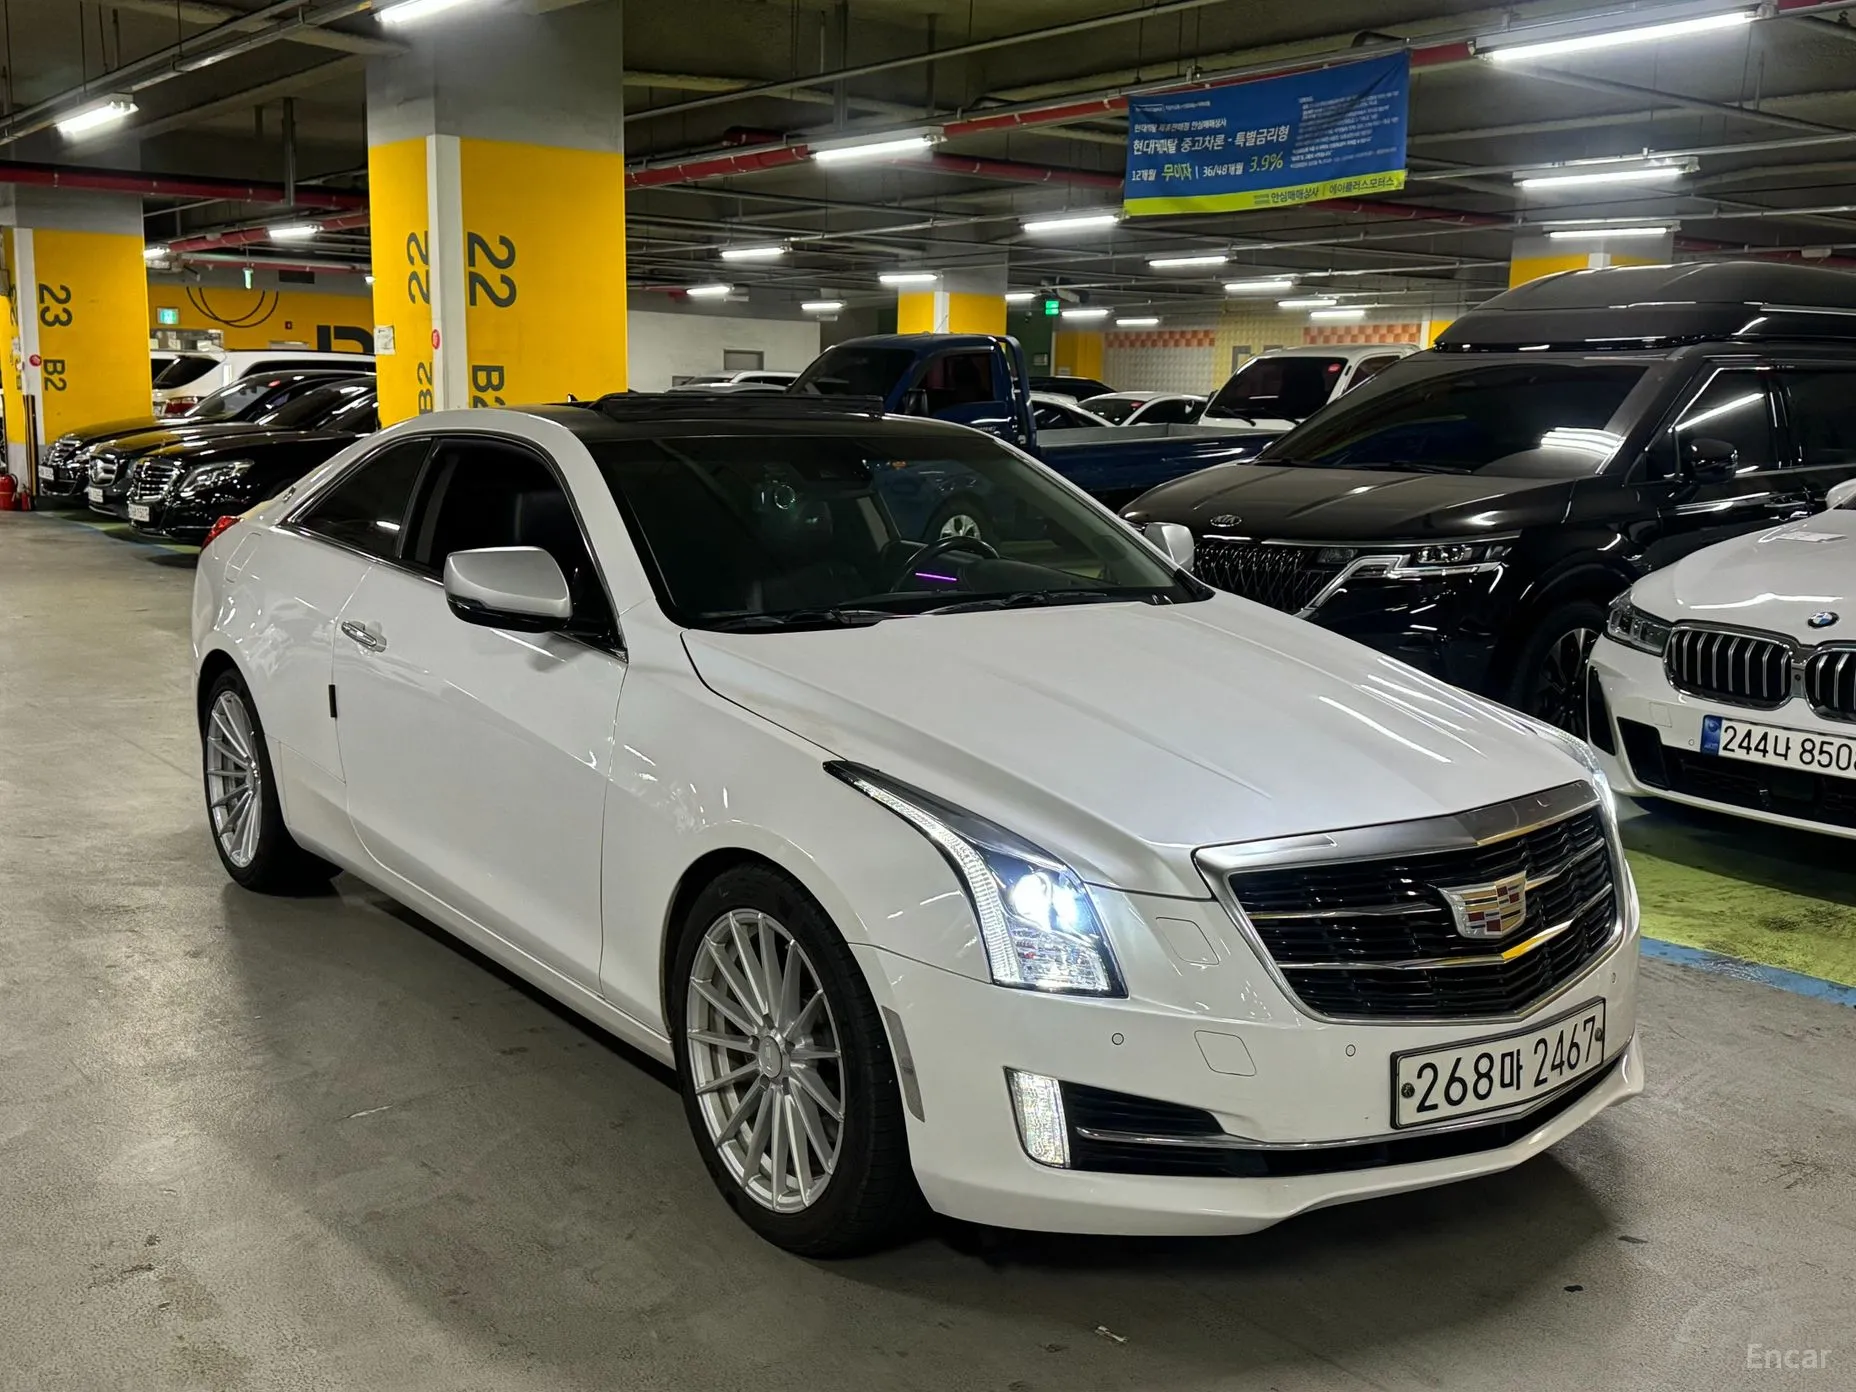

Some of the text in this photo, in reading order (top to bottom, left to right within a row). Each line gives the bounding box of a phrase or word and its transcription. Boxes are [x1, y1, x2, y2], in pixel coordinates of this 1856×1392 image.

[1180, 134, 1226, 152] 중고차론
[1234, 125, 1290, 148] 특별금리형
[1132, 168, 1157, 181] 12개월
[1162, 162, 1192, 182] 무이자
[1249, 151, 1284, 173] 3.9%
[1271, 187, 1319, 203] 안심매매상사
[1329, 177, 1395, 195] 에이플러스모터스
[407, 230, 430, 305] 22
[467, 231, 517, 308] 22
[39, 283, 72, 328] 23
[43, 359, 67, 391] B2
[417, 361, 433, 415] B2
[1722, 725, 1856, 771] 244나 850
[1416, 1015, 1596, 1113] 268마 2467
